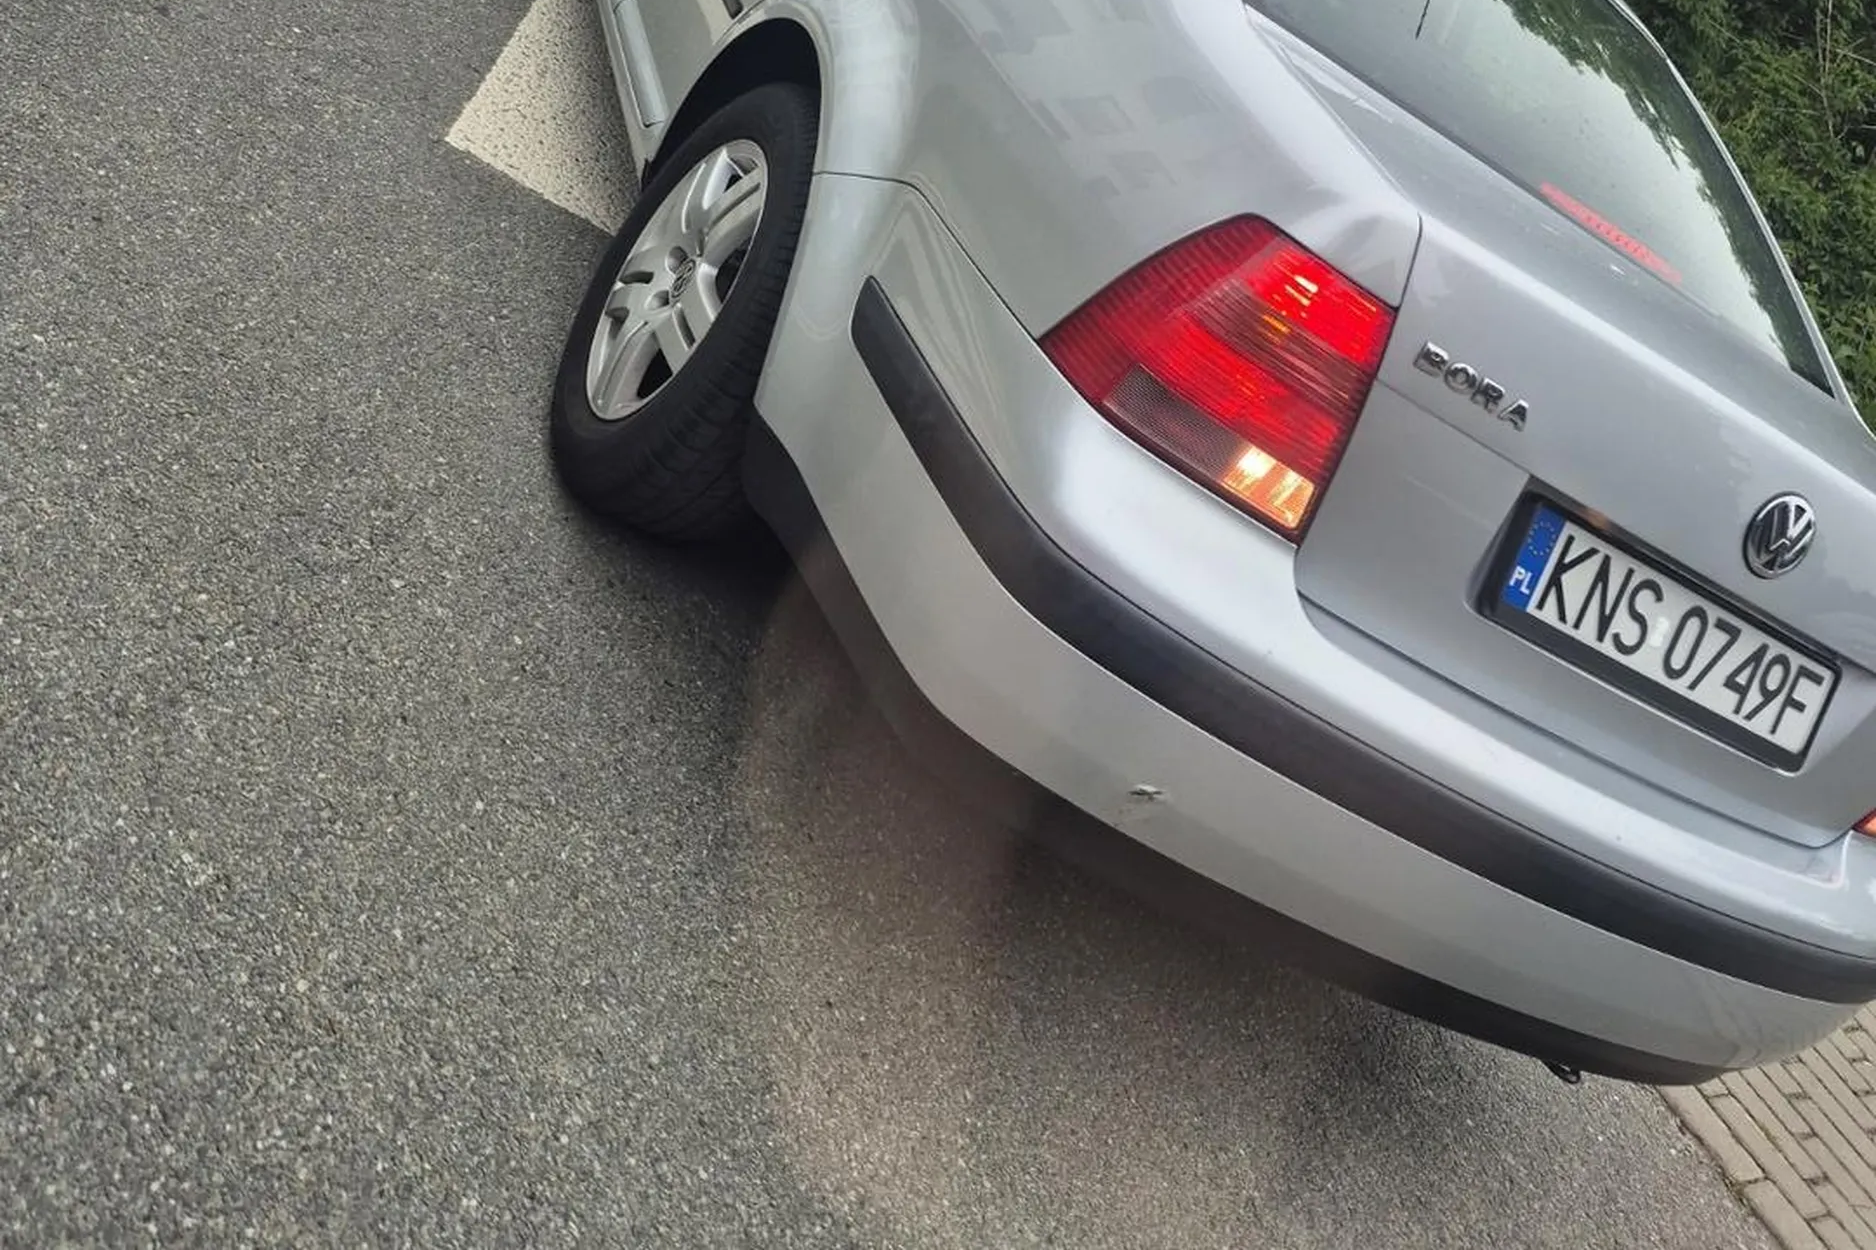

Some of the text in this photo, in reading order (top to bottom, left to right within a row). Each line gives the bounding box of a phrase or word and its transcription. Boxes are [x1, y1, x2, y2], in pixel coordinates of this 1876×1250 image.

[1412, 341, 1530, 432] BORA
[1509, 565, 1532, 596] PL
[1536, 535, 1825, 735] KNS 0749F
